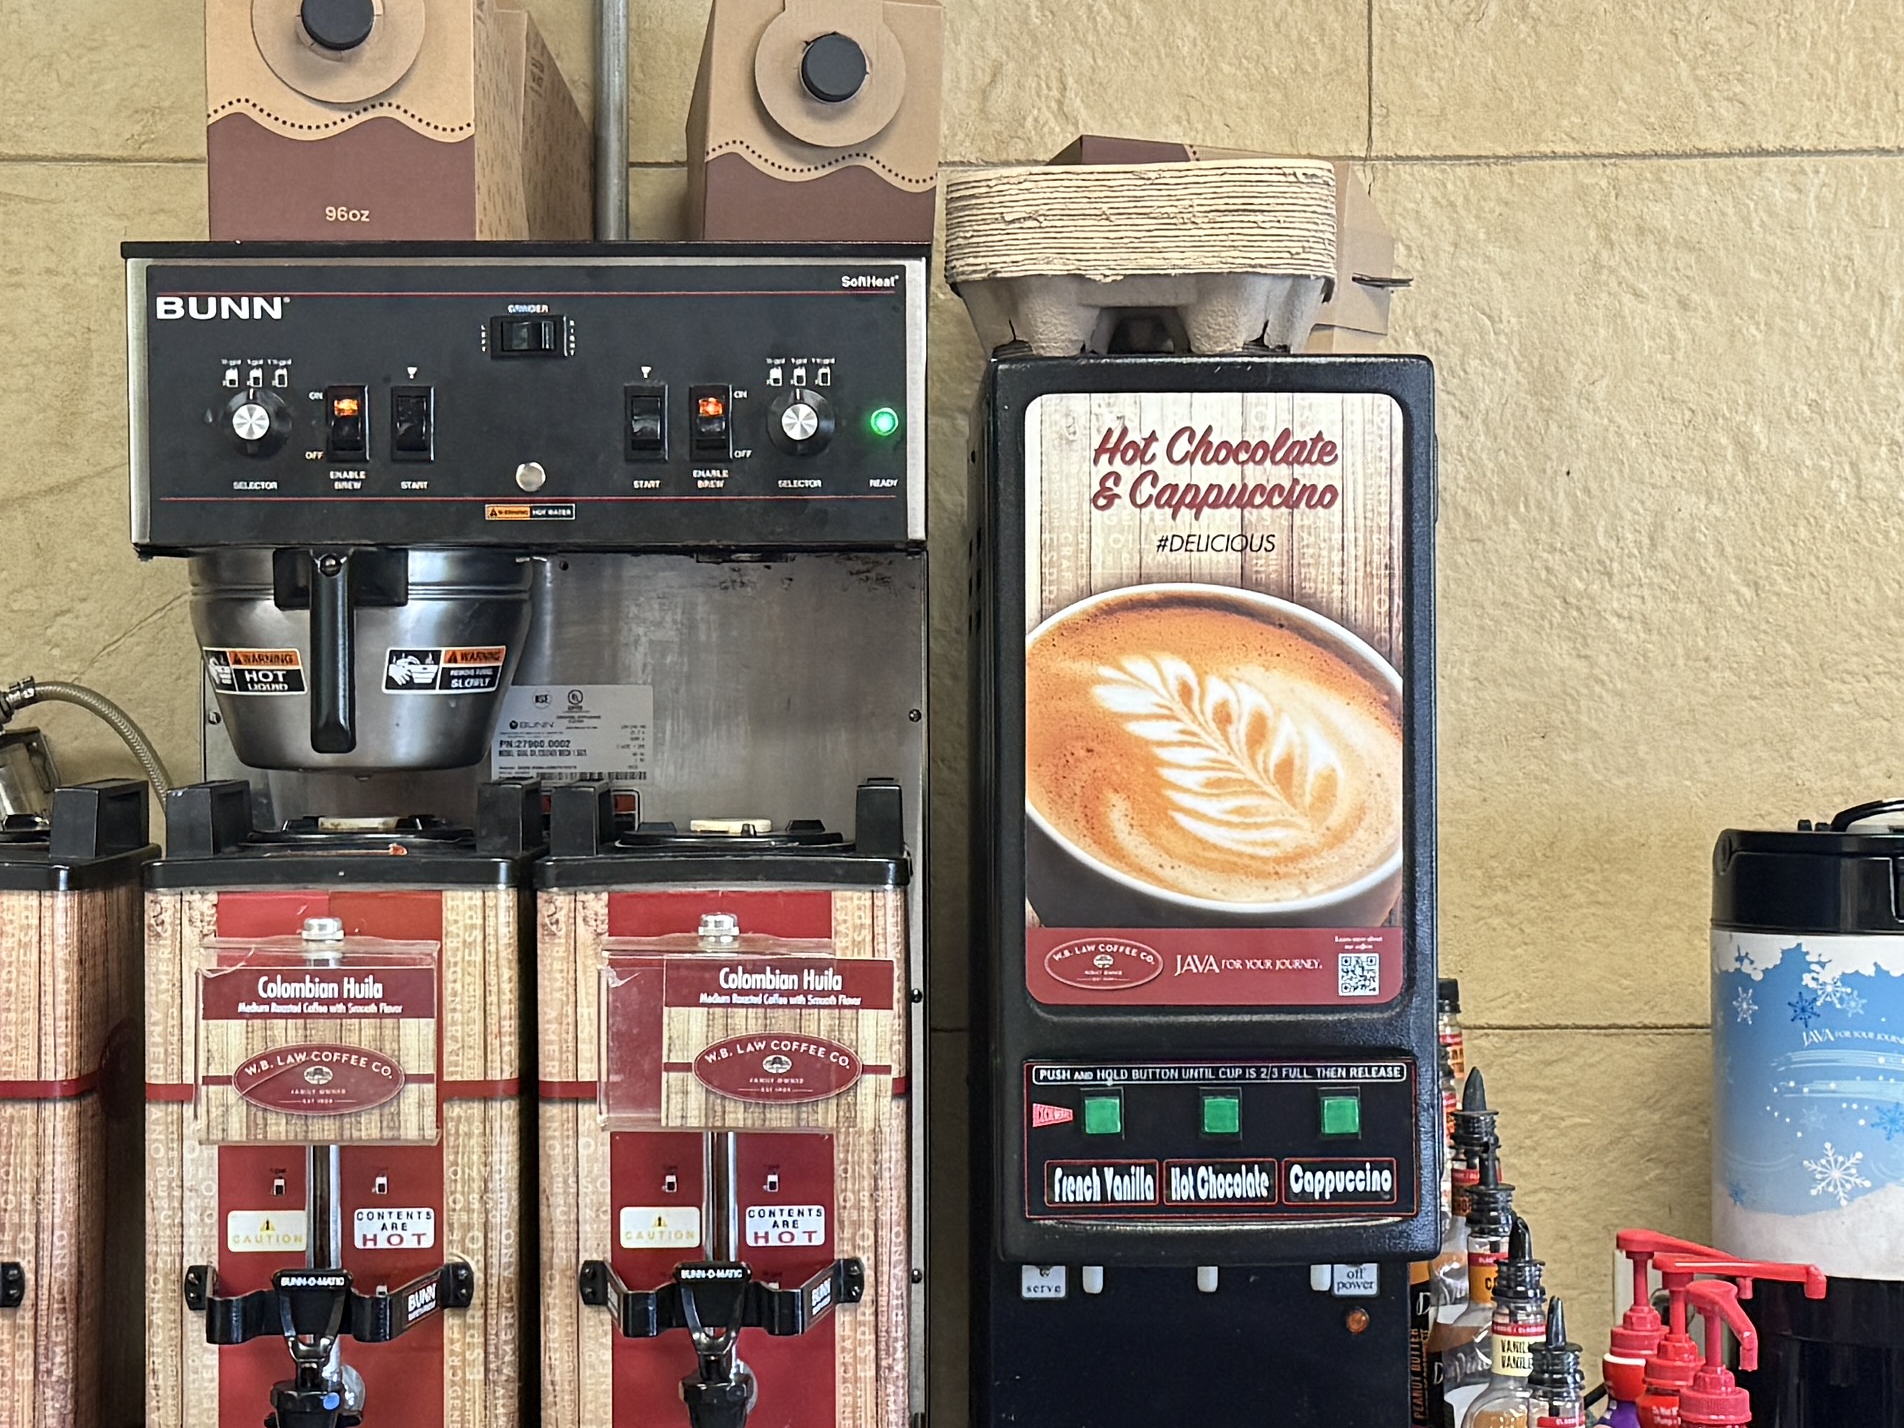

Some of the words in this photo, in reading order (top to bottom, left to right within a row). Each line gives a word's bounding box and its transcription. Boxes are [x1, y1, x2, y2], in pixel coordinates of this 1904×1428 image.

[325, 204, 371, 224] 96oz
[841, 275, 897, 289] SoftHeat
[155, 297, 283, 320] BUNN
[309, 392, 324, 400] ON
[1093, 425, 1159, 466] Hot
[1166, 424, 1339, 466] Chocolate
[305, 451, 324, 460] OFF
[329, 471, 366, 480] ENABLE
[233, 481, 278, 490] SELECTOR
[401, 481, 428, 490] START
[633, 480, 661, 489] START
[777, 479, 822, 489] SELECTOR
[870, 479, 898, 488] READY
[1092, 471, 1122, 511] &
[1129, 470, 1339, 522] Cappuccino
[1156, 534, 1276, 553] #DELICIOUS
[244, 654, 293, 665] WARNING
[246, 670, 287, 682] HOT
[248, 683, 288, 691] LIQUID
[450, 678, 489, 688] SLOWLY
[1174, 954, 1220, 977] JAVA
[1222, 958, 1242, 970] FOR
[1245, 959, 1273, 970] YOUR
[719, 966, 798, 990] Colombian
[803, 968, 842, 991] Huila
[257, 974, 339, 999] Colombian
[343, 975, 383, 999] Huila
[764, 994, 788, 1005] Coffee
[789, 994, 806, 1005] with
[1803, 1028, 1834, 1047] JAVA
[704, 1047, 733, 1064] W.B.
[737, 1040, 767, 1054] LAW
[771, 1040, 825, 1058] COFFEE
[829, 1051, 850, 1069] CO.
[1040, 1069, 1070, 1080] PUSH
[1074, 1072, 1094, 1080] AND
[1096, 1069, 1128, 1080] HOLD
[1132, 1069, 1178, 1079] BUTTON
[1182, 1068, 1215, 1079] UNTIL
[1219, 1068, 1242, 1078] CUP
[1246, 1068, 1256, 1078] IS
[1260, 1067, 1278, 1079] 2/3
[1317, 1067, 1345, 1078] THEN
[1350, 1067, 1401, 1078] RELEASE
[1054, 1167, 1101, 1202] French
[1104, 1166, 1154, 1202] Vanilla
[1170, 1166, 1195, 1201] Hot
[1197, 1164, 1270, 1200] Chocolate
[1290, 1162, 1392, 1200] Cappuccino
[356, 1211, 432, 1221] CONTENTS
[747, 1208, 822, 1218] CONTENTS
[380, 1223, 408, 1231] ARE
[772, 1220, 799, 1229] ARE
[232, 1234, 305, 1244] CAUTION
[362, 1233, 427, 1246] HOT
[625, 1230, 695, 1240] CAUTION
[754, 1231, 818, 1244] HOT
[1026, 1284, 1062, 1294] serve
[1337, 1279, 1375, 1292] power
